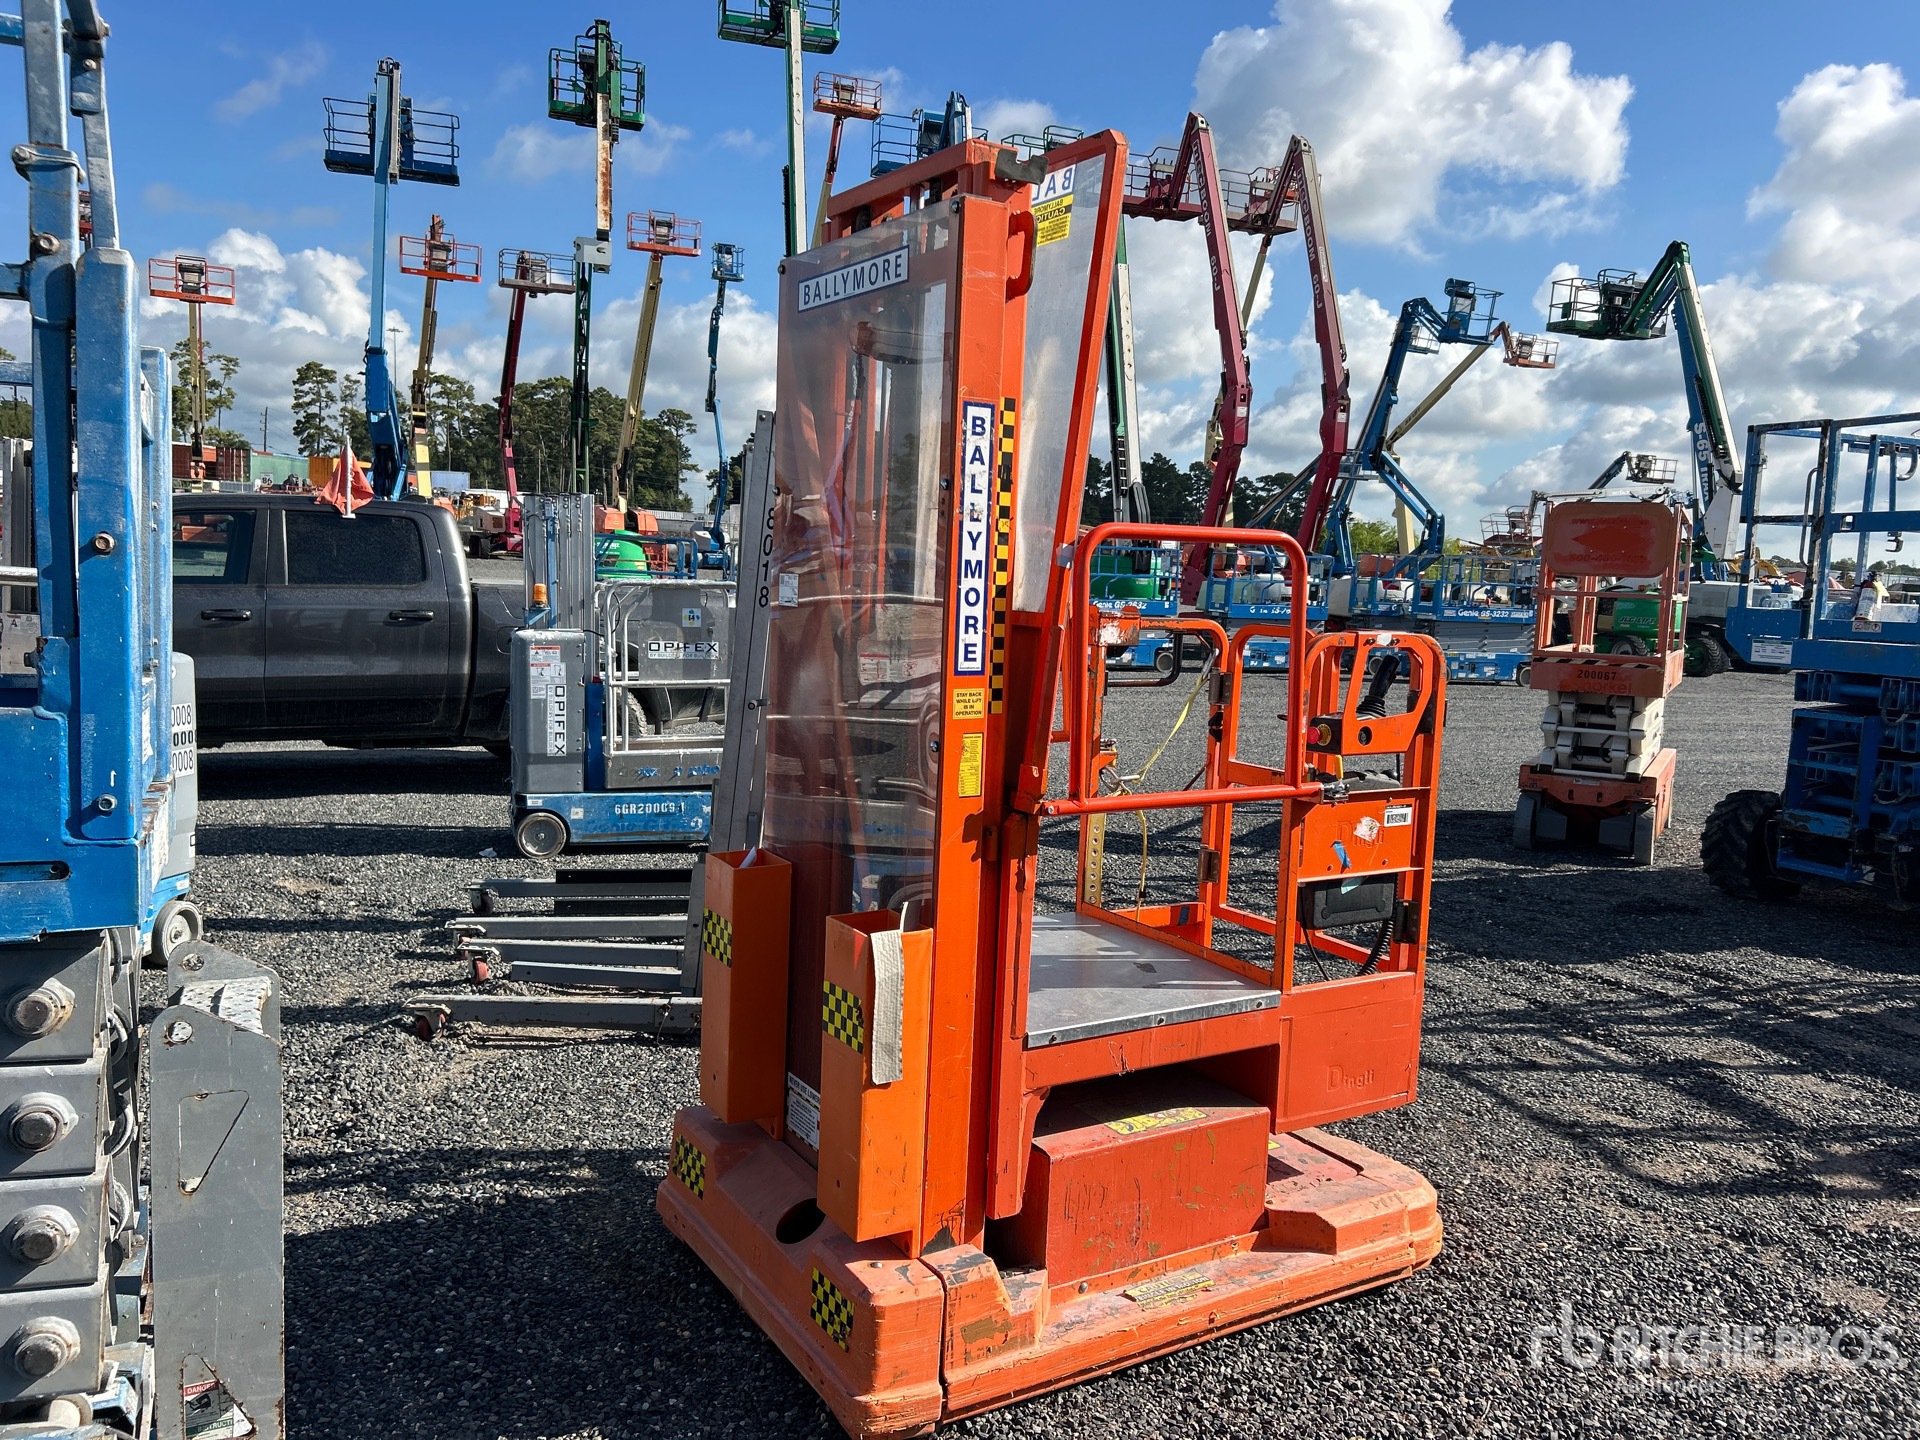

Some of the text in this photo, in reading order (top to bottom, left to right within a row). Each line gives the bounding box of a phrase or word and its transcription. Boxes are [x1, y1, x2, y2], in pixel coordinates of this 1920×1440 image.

[1200, 189, 1212, 237] BOOM
[1303, 213, 1315, 262] BOOM
[803, 253, 902, 306] BALLYMORE
[1693, 422, 1711, 462] S-65
[963, 415, 987, 662] BALLYMORE
[1458, 608, 1479, 617] Genie
[1480, 609, 1509, 618] GS-3232
[1618, 616, 1634, 624] JLG
[649, 642, 718, 653] OPIFEX
[1577, 669, 1617, 681] 200067
[554, 685, 565, 756] OPIFEX
[1327, 1064, 1375, 1093] Dingli
